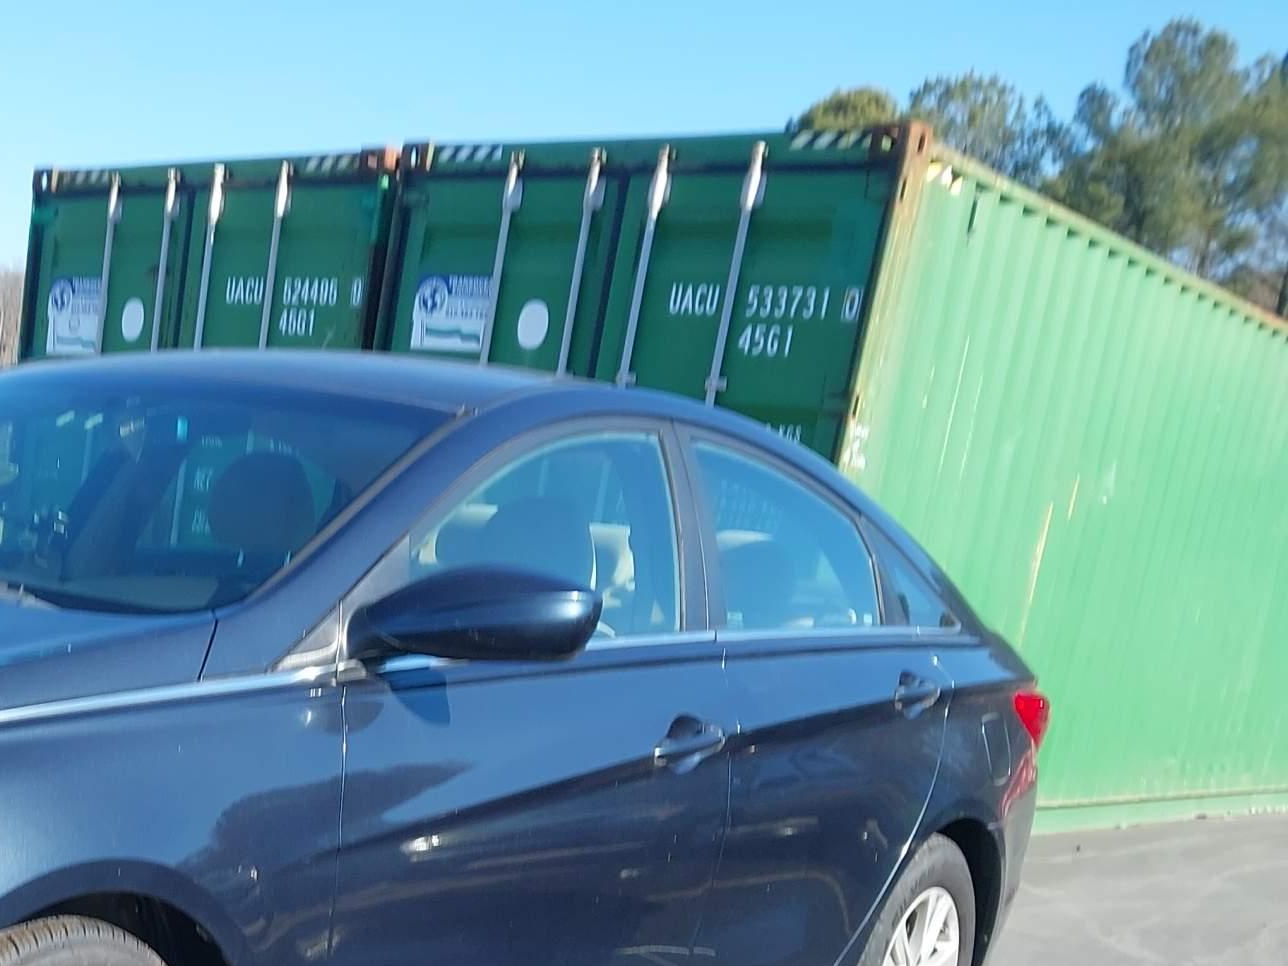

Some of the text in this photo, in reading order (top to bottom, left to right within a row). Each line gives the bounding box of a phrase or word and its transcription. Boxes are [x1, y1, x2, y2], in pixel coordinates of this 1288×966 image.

[225, 276, 263, 305] UACU
[669, 282, 862, 321] UACU 533731 0
[738, 323, 794, 358] 45G1
